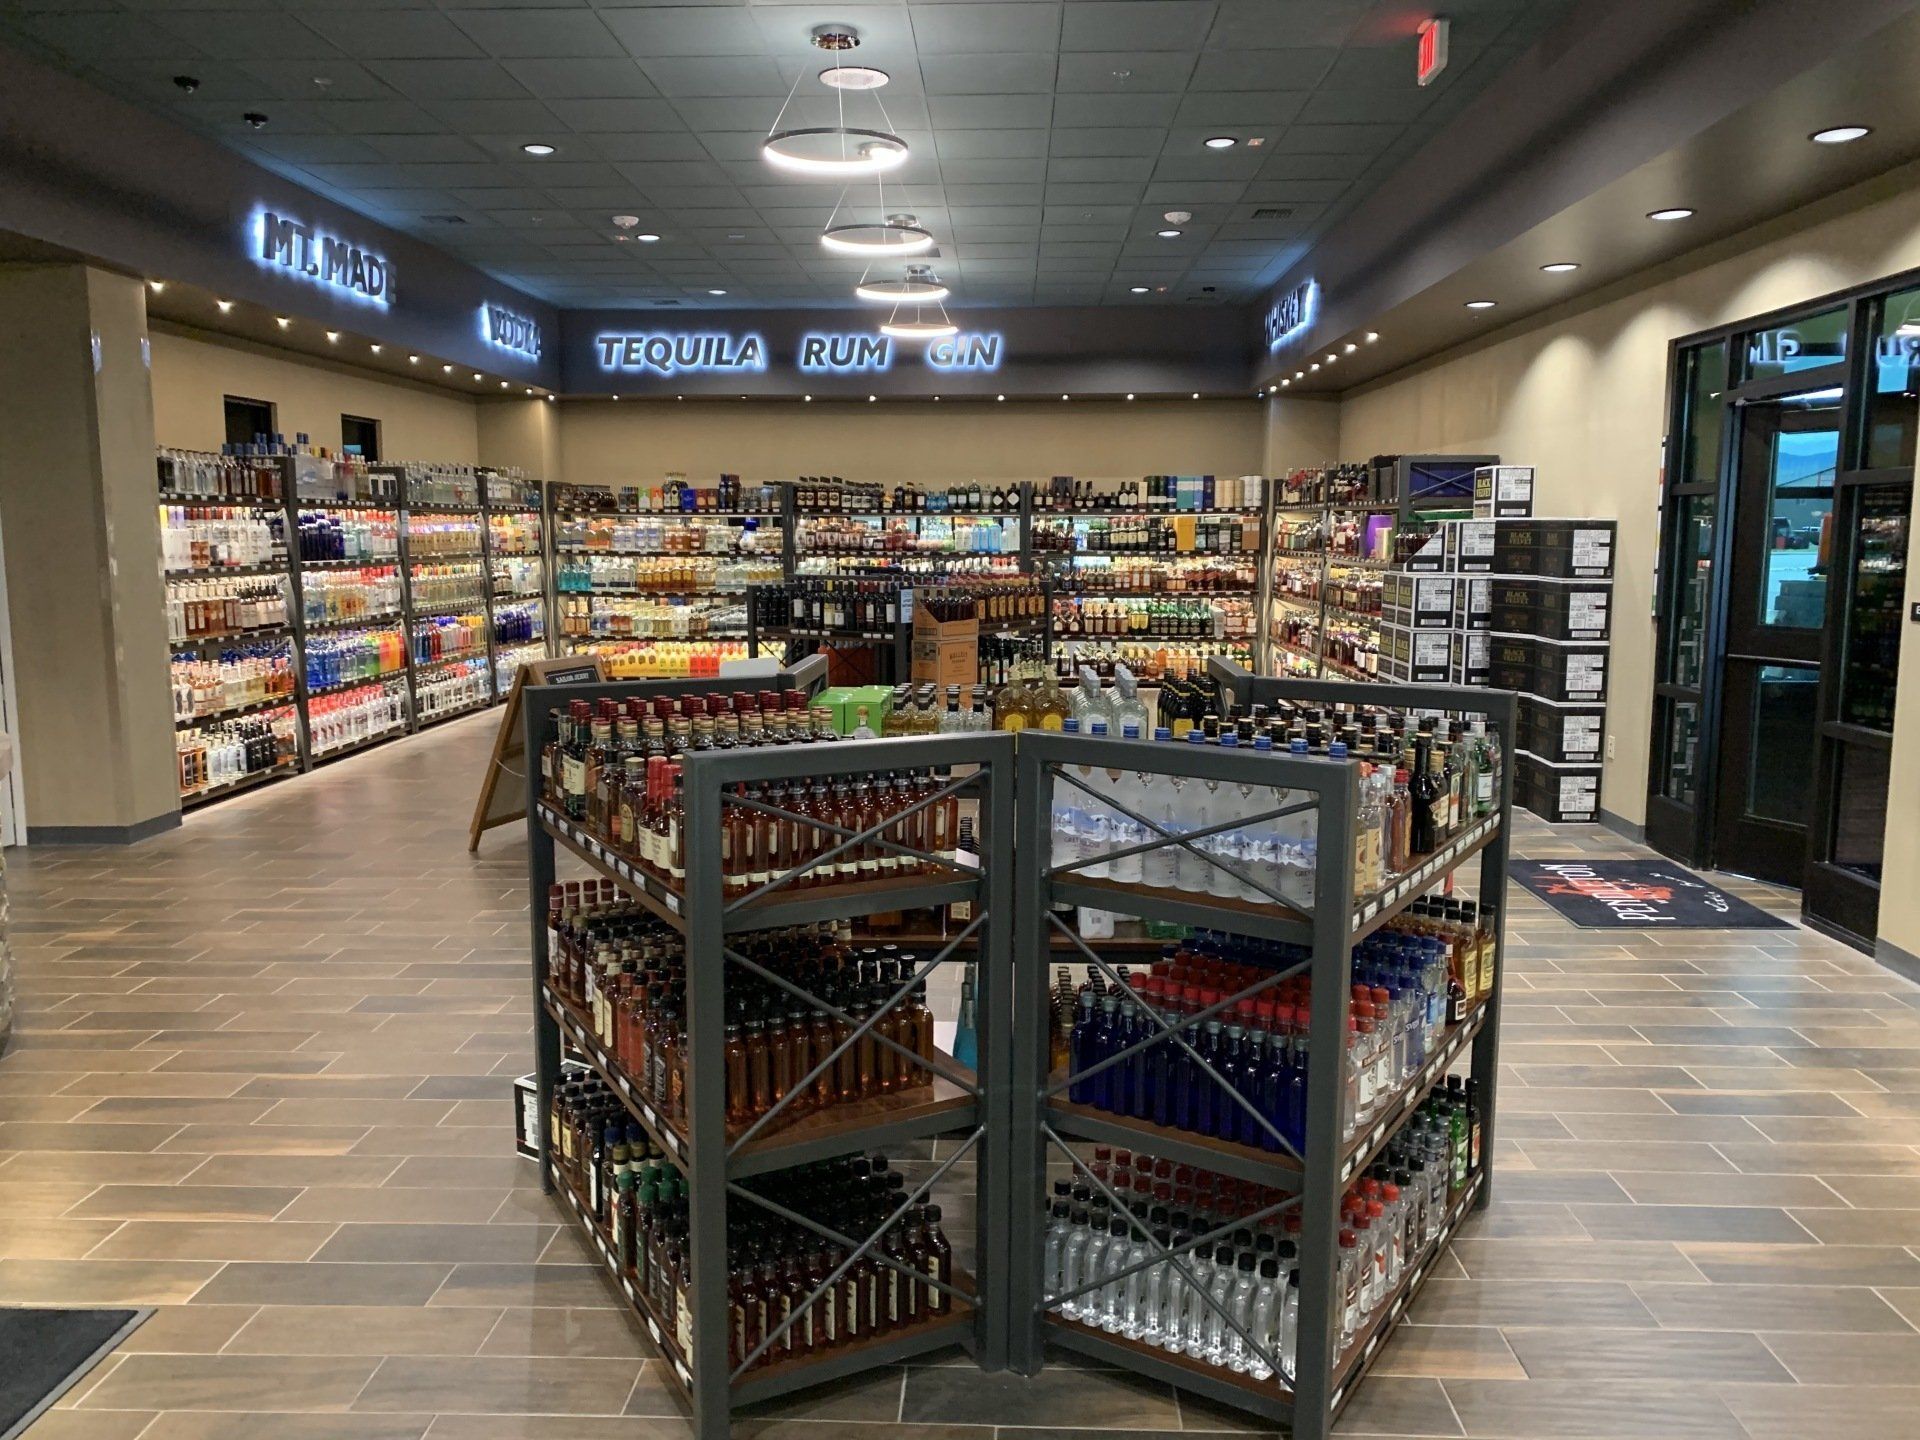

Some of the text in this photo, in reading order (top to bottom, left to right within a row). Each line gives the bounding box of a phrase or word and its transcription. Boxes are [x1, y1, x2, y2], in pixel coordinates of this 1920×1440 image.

[263, 212, 397, 304] MT. MADE
[488, 305, 543, 357] VODKA
[598, 336, 999, 372] TEQUILA RUM GIN
[1539, 863, 1677, 922] PENDLETON
